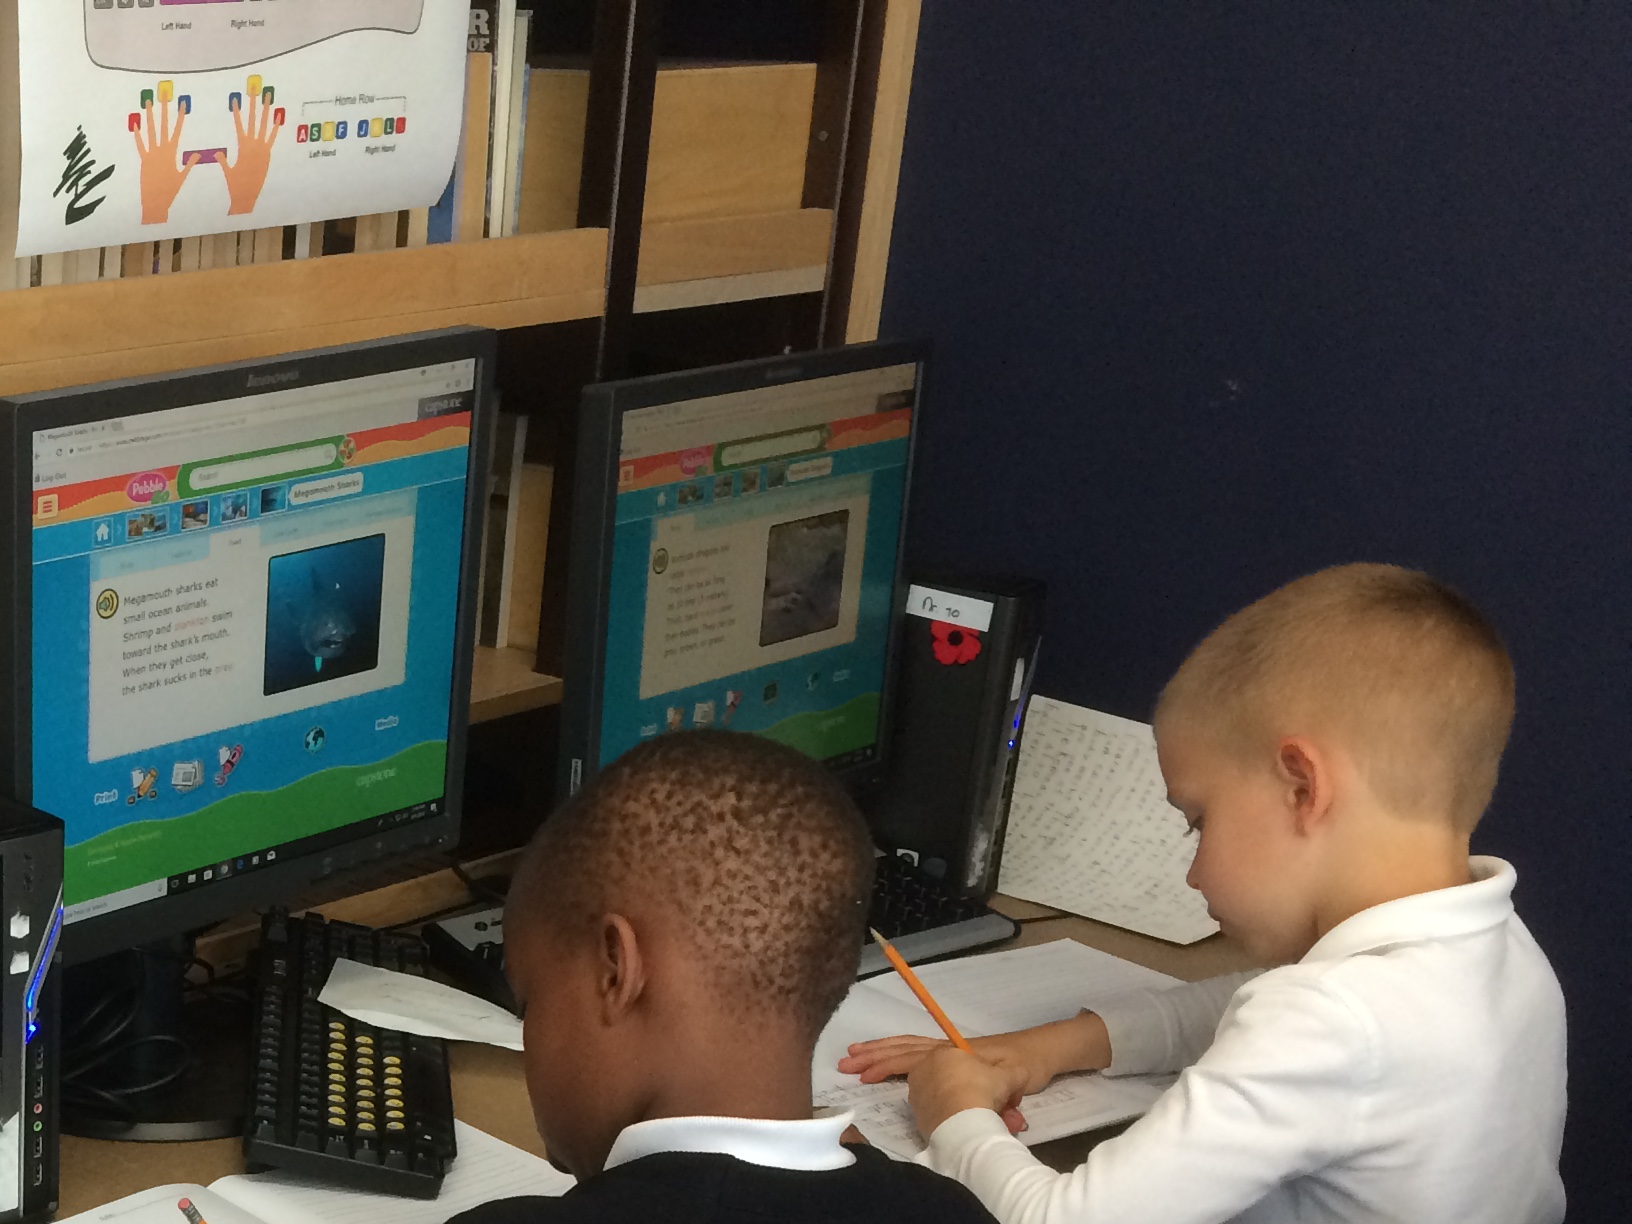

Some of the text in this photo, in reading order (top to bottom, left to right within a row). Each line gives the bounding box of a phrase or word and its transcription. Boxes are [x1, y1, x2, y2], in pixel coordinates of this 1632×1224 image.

[161, 21, 192, 31] Left Hand
[231, 18, 265, 29] Right Hand
[335, 93, 375, 106] Home Row
[132, 480, 166, 496] Pebble
[293, 477, 360, 500] Megamouth Sharks
[123, 577, 219, 607] Megamouth sharks eat
[123, 611, 146, 625] small
[148, 606, 173, 618] ocean
[123, 628, 154, 643] Shrimp
[156, 622, 172, 635] and
[211, 609, 233, 623] swim
[122, 628, 230, 661] toward the shark's mouth.
[122, 664, 147, 678] When
[148, 658, 169, 675] they
[170, 655, 184, 668] get
[122, 666, 212, 696] the shark sucks in the
[95, 790, 118, 805] Print
